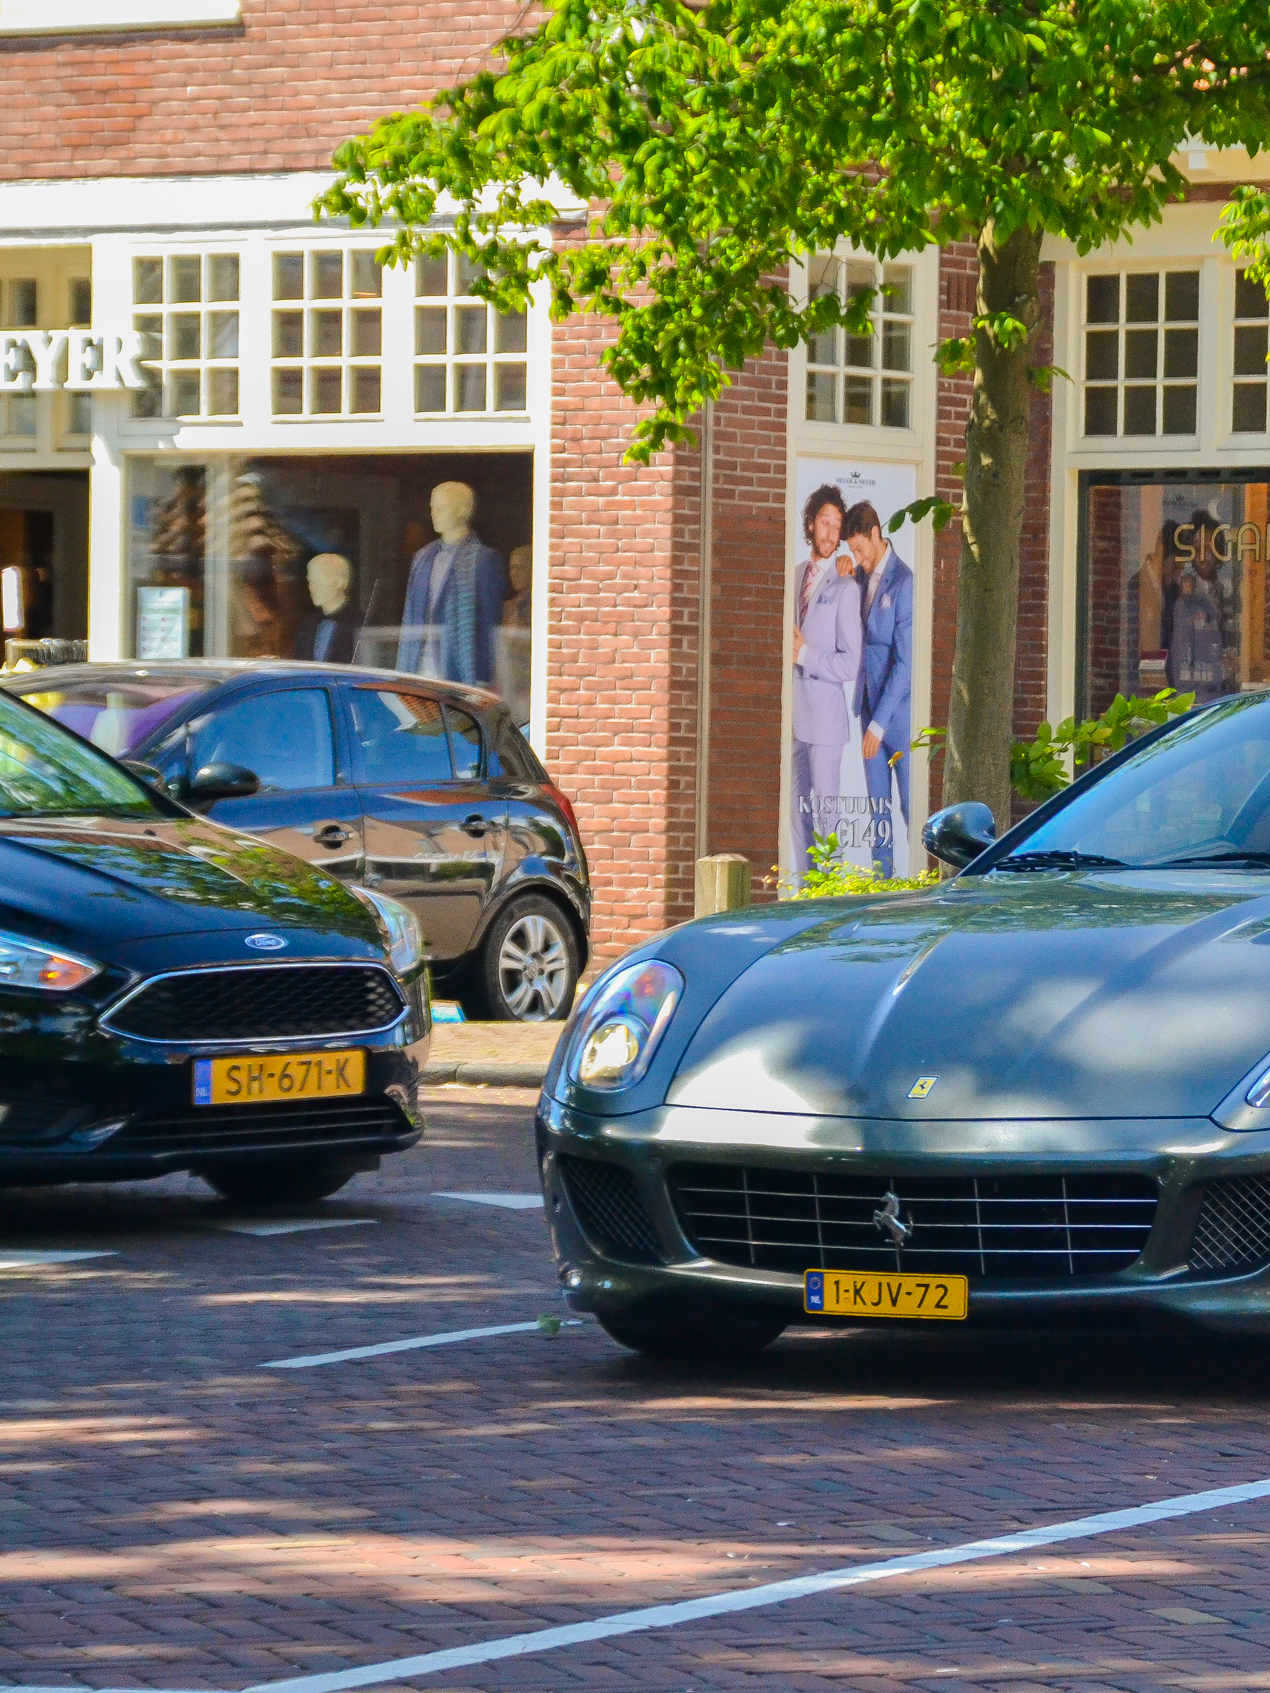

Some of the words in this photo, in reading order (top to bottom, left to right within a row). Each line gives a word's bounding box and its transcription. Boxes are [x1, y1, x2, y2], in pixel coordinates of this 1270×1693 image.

[797, 795, 893, 814] KOSTUUMS
[195, 1087, 208, 1098] NL
[225, 1057, 351, 1097] SH-671-K
[810, 1294, 821, 1304] NL
[833, 1279, 949, 1309] 1-KJV-72
